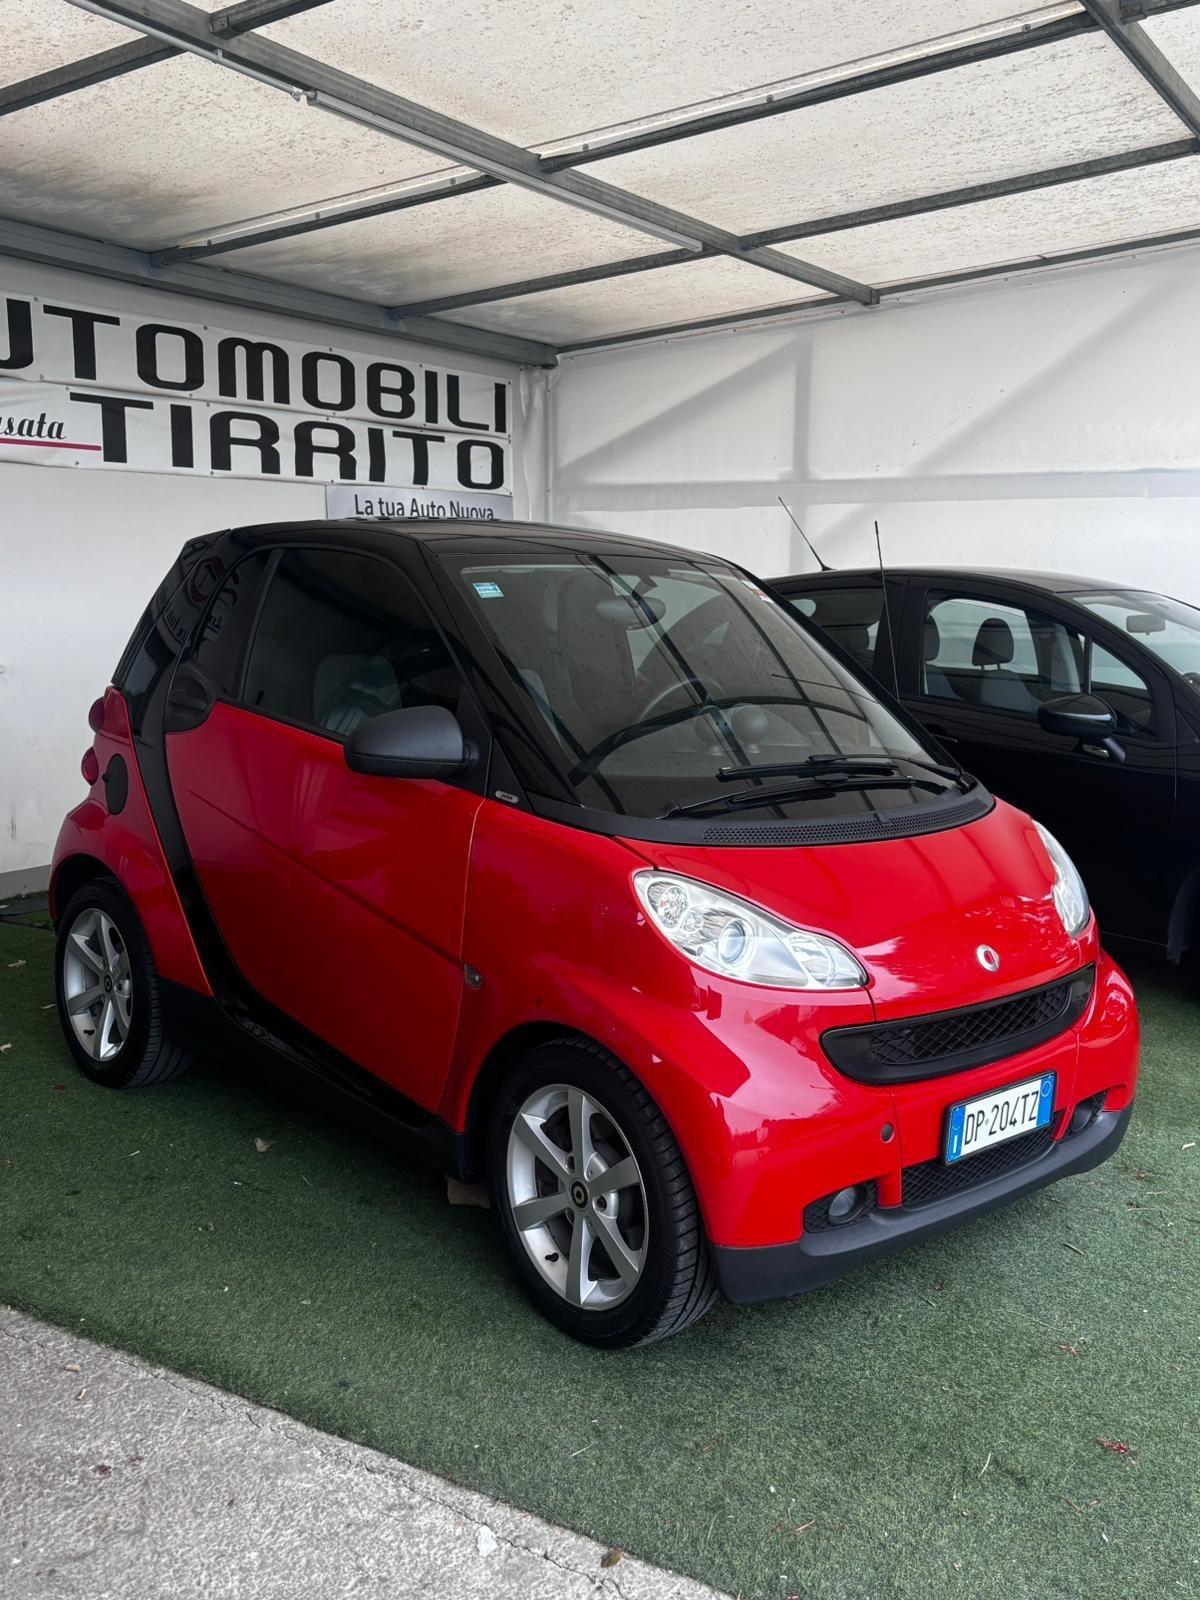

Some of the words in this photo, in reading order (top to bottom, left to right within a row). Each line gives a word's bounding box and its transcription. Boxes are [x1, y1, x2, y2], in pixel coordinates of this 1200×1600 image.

[0, 413, 66, 440] sata
[69, 392, 504, 490] TIRRITO
[354, 494, 374, 515] La
[378, 497, 405, 516] tua
[410, 498, 446, 517] Auto
[450, 501, 494, 519] Nuova
